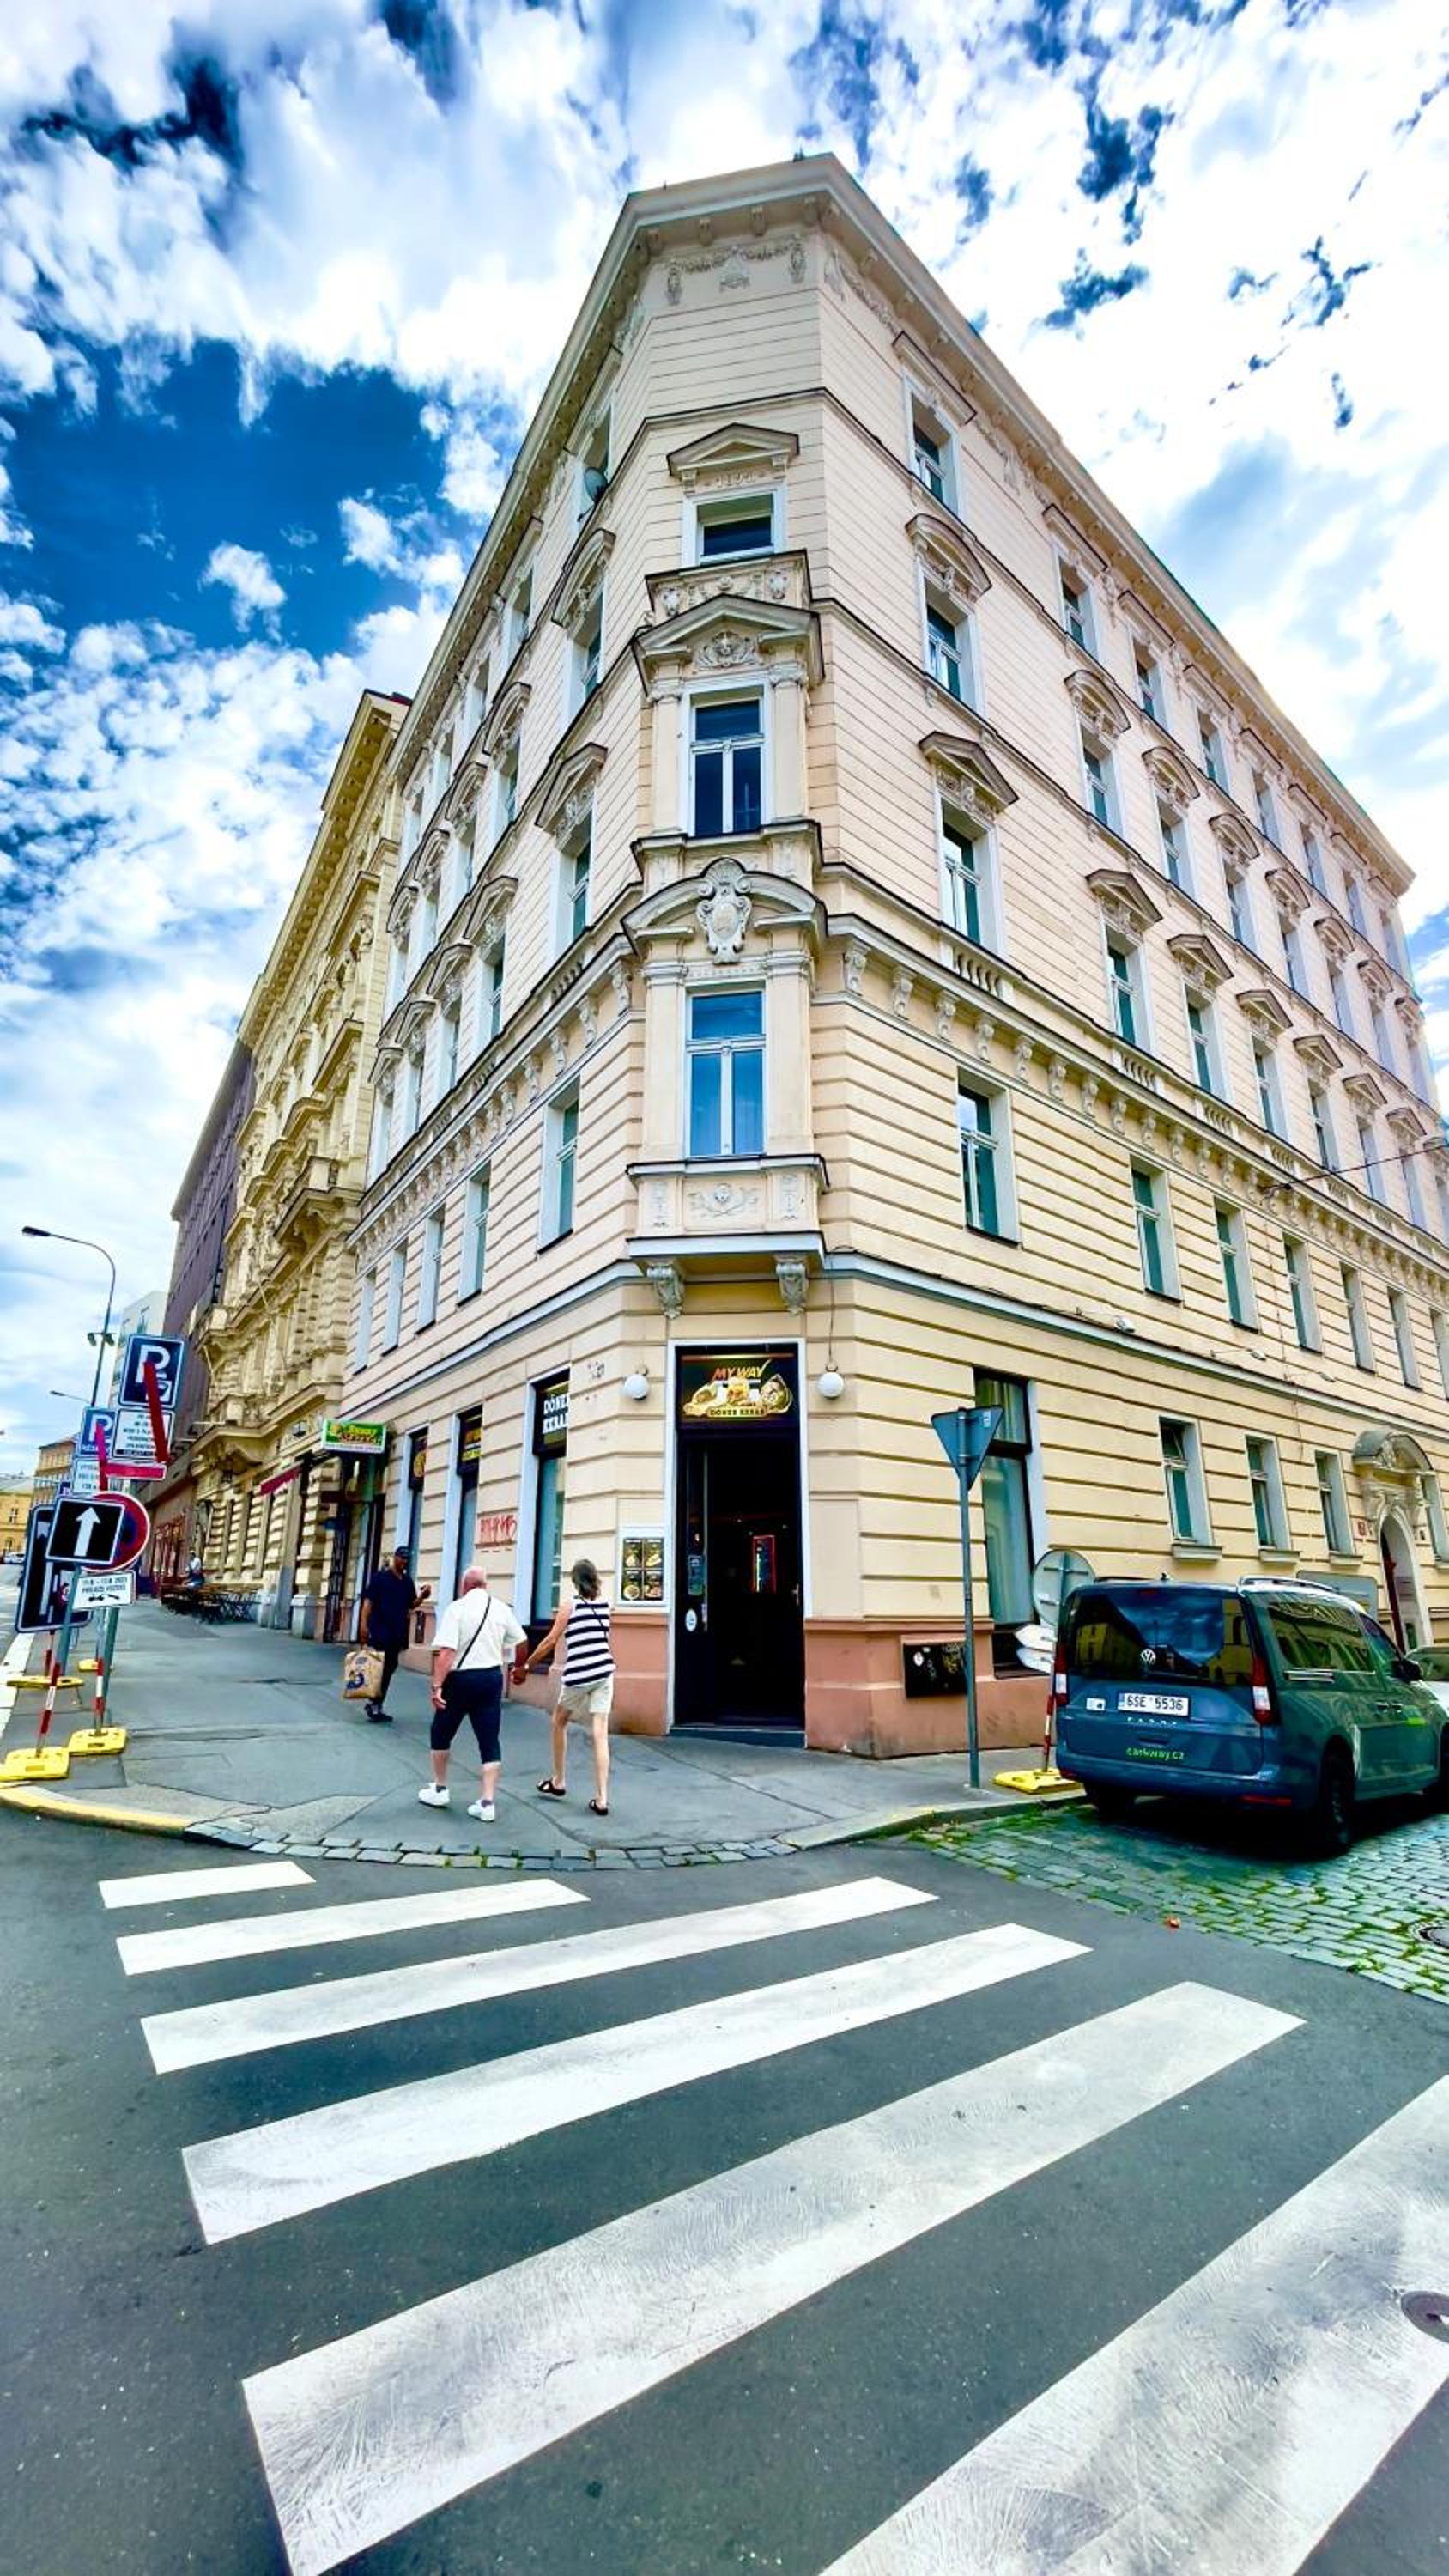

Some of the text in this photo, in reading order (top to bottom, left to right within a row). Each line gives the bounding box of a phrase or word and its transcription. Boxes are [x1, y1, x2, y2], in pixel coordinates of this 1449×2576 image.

[714, 1360, 771, 1378] MY WAY
[544, 1394, 568, 1415] DÖNE
[543, 1413, 568, 1434] KEBA
[1127, 1695, 1184, 1711] 6SE 5536
